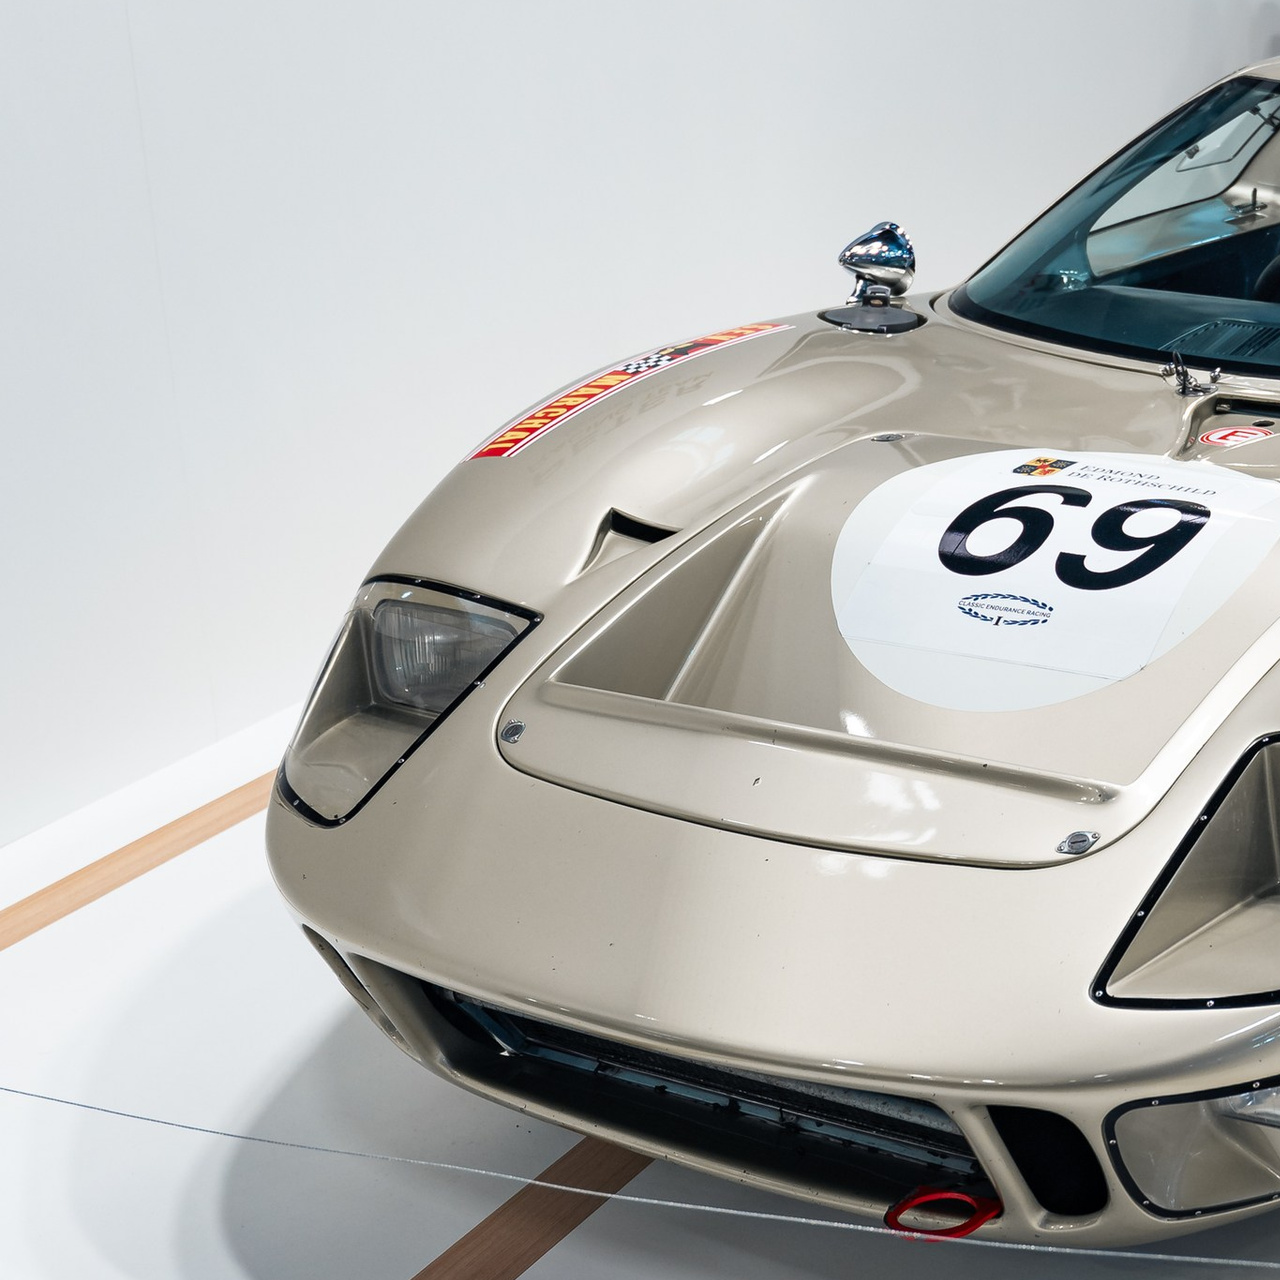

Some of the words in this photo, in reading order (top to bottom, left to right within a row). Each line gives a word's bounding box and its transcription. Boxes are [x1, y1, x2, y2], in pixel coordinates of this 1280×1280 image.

[481, 373, 633, 454] MARCHAL
[1067, 471, 1090, 480] DE
[1097, 474, 1216, 496] ROTHSCHILD
[1079, 465, 1160, 480] EDMOND
[938, 485, 1211, 590] 69
[958, 600, 985, 609] CLASSIC
[986, 604, 1025, 615] ENDURANCE
[1026, 610, 1051, 618] RACING
